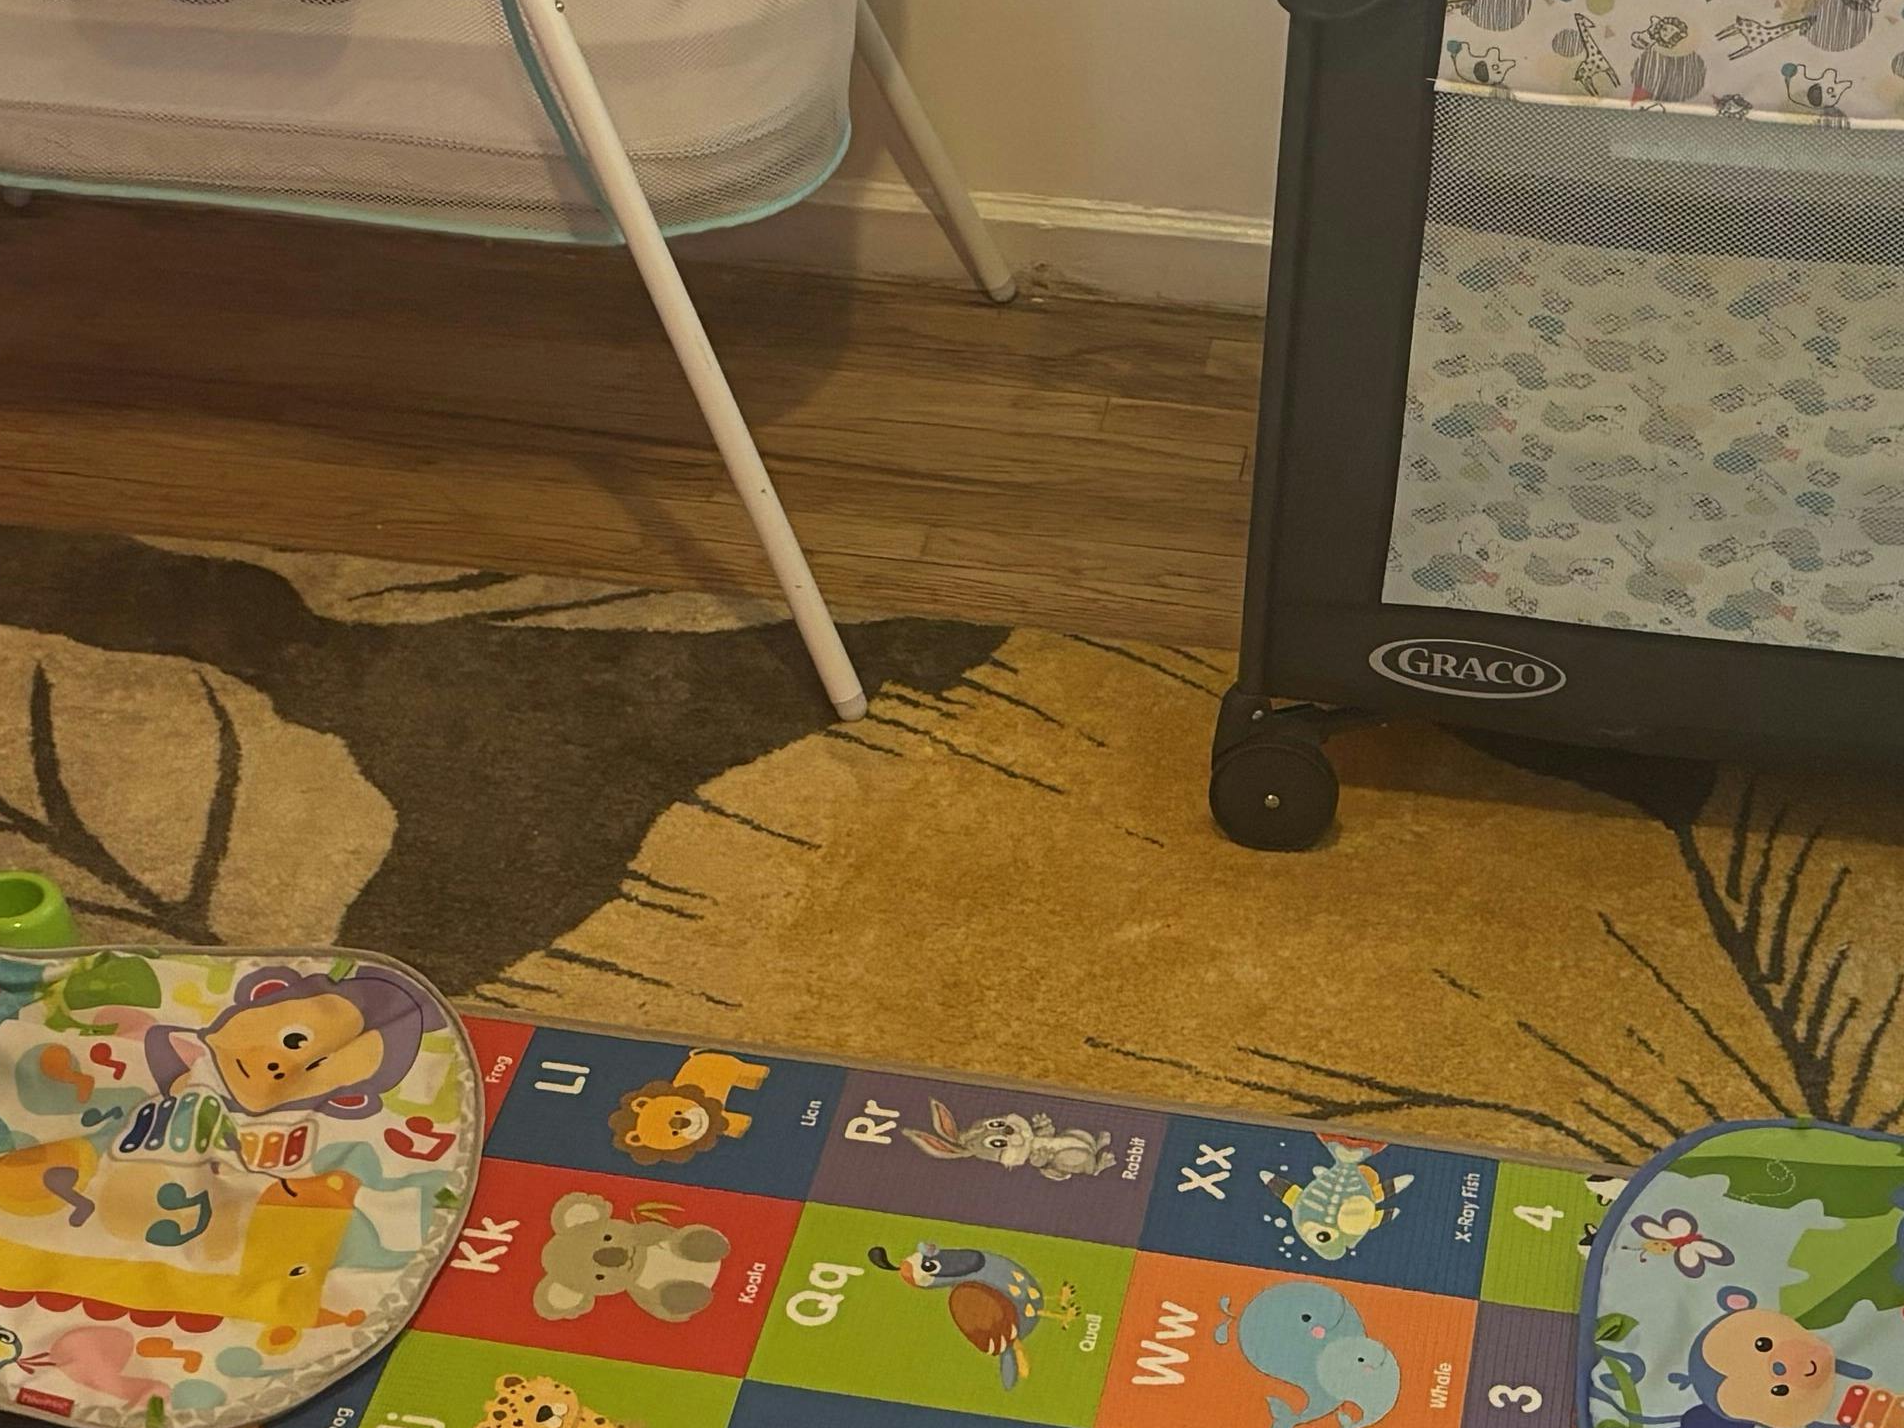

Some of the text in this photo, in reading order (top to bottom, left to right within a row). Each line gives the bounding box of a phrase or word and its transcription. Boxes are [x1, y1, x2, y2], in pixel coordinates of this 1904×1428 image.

[1398, 647, 1545, 687] GRACO
[485, 1053, 513, 1087] Frog
[534, 1061, 590, 1095] Ll
[800, 1098, 823, 1129] Lion
[844, 1099, 901, 1147] Rr
[1122, 1135, 1148, 1181] Rabbit
[1177, 1142, 1236, 1201] Xx
[1453, 1172, 1482, 1243] X-Ray Fish
[1512, 1204, 1565, 1232] 4
[452, 1214, 521, 1275] Kk
[738, 1261, 767, 1306] Koala
[785, 1260, 865, 1327] Qq
[1078, 1312, 1103, 1353] Quail
[1130, 1300, 1201, 1388] Ww
[1429, 1361, 1453, 1411] Whale
[1488, 1384, 1543, 1413] 3
